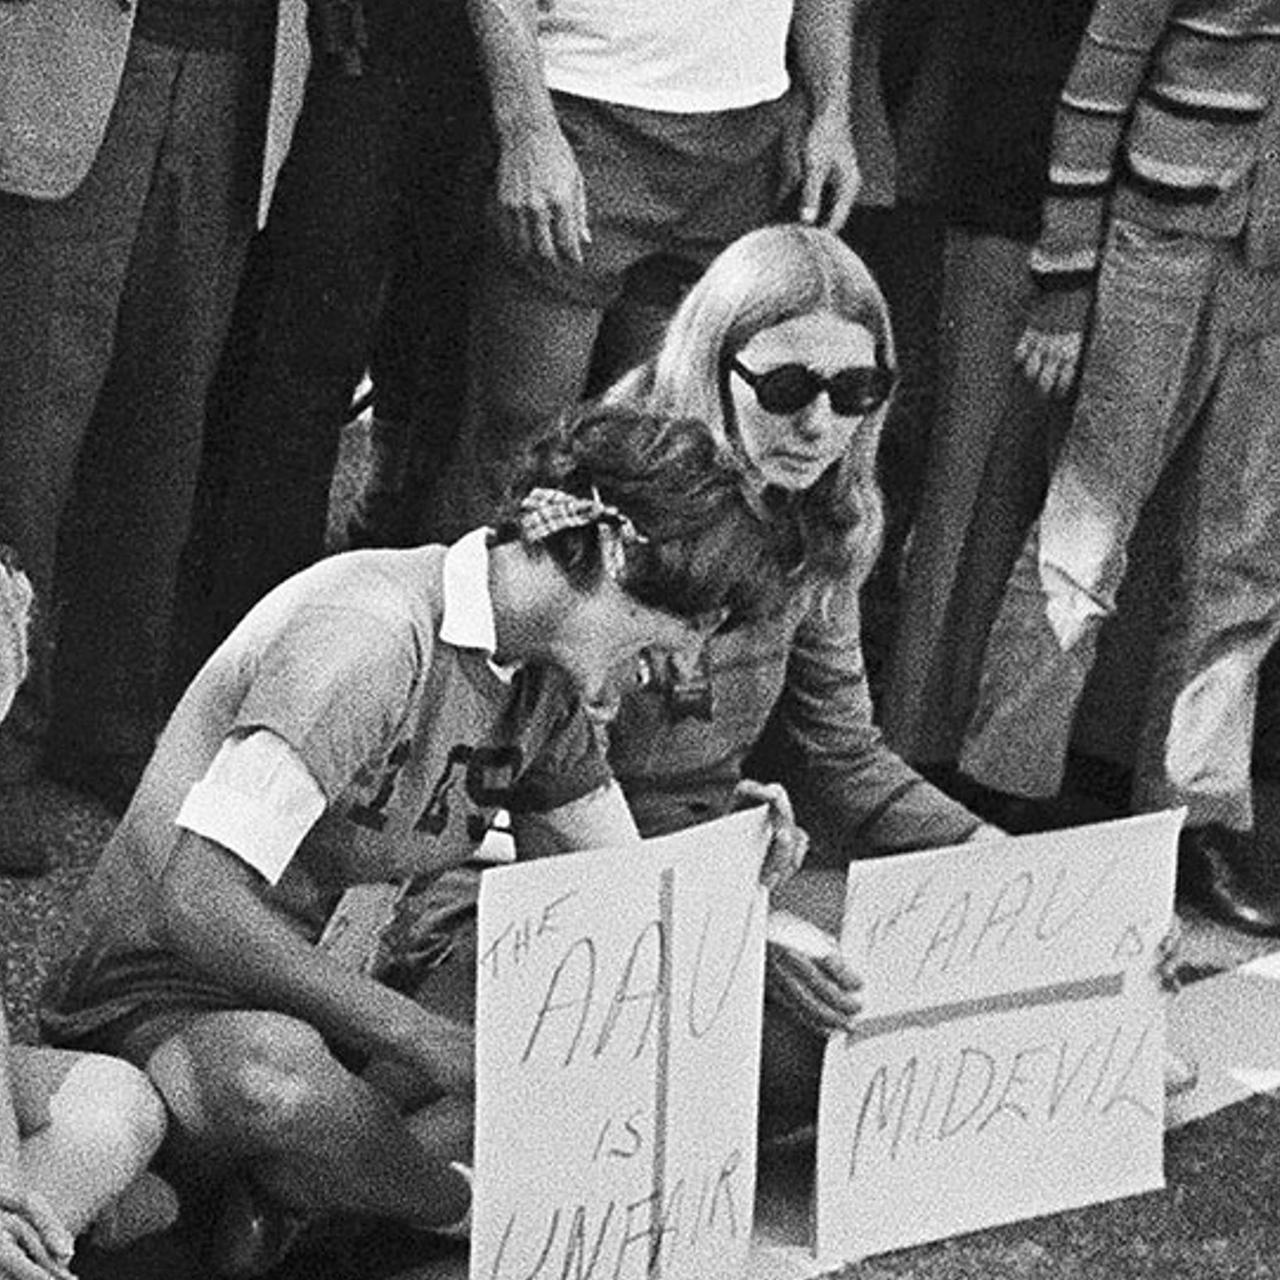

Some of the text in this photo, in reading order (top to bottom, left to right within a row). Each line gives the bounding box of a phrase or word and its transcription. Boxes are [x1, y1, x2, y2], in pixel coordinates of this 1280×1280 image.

[481, 889, 755, 1066] THE AAU
[592, 1114, 642, 1162] IS
[846, 1022, 1157, 1182] MIDEVIL
